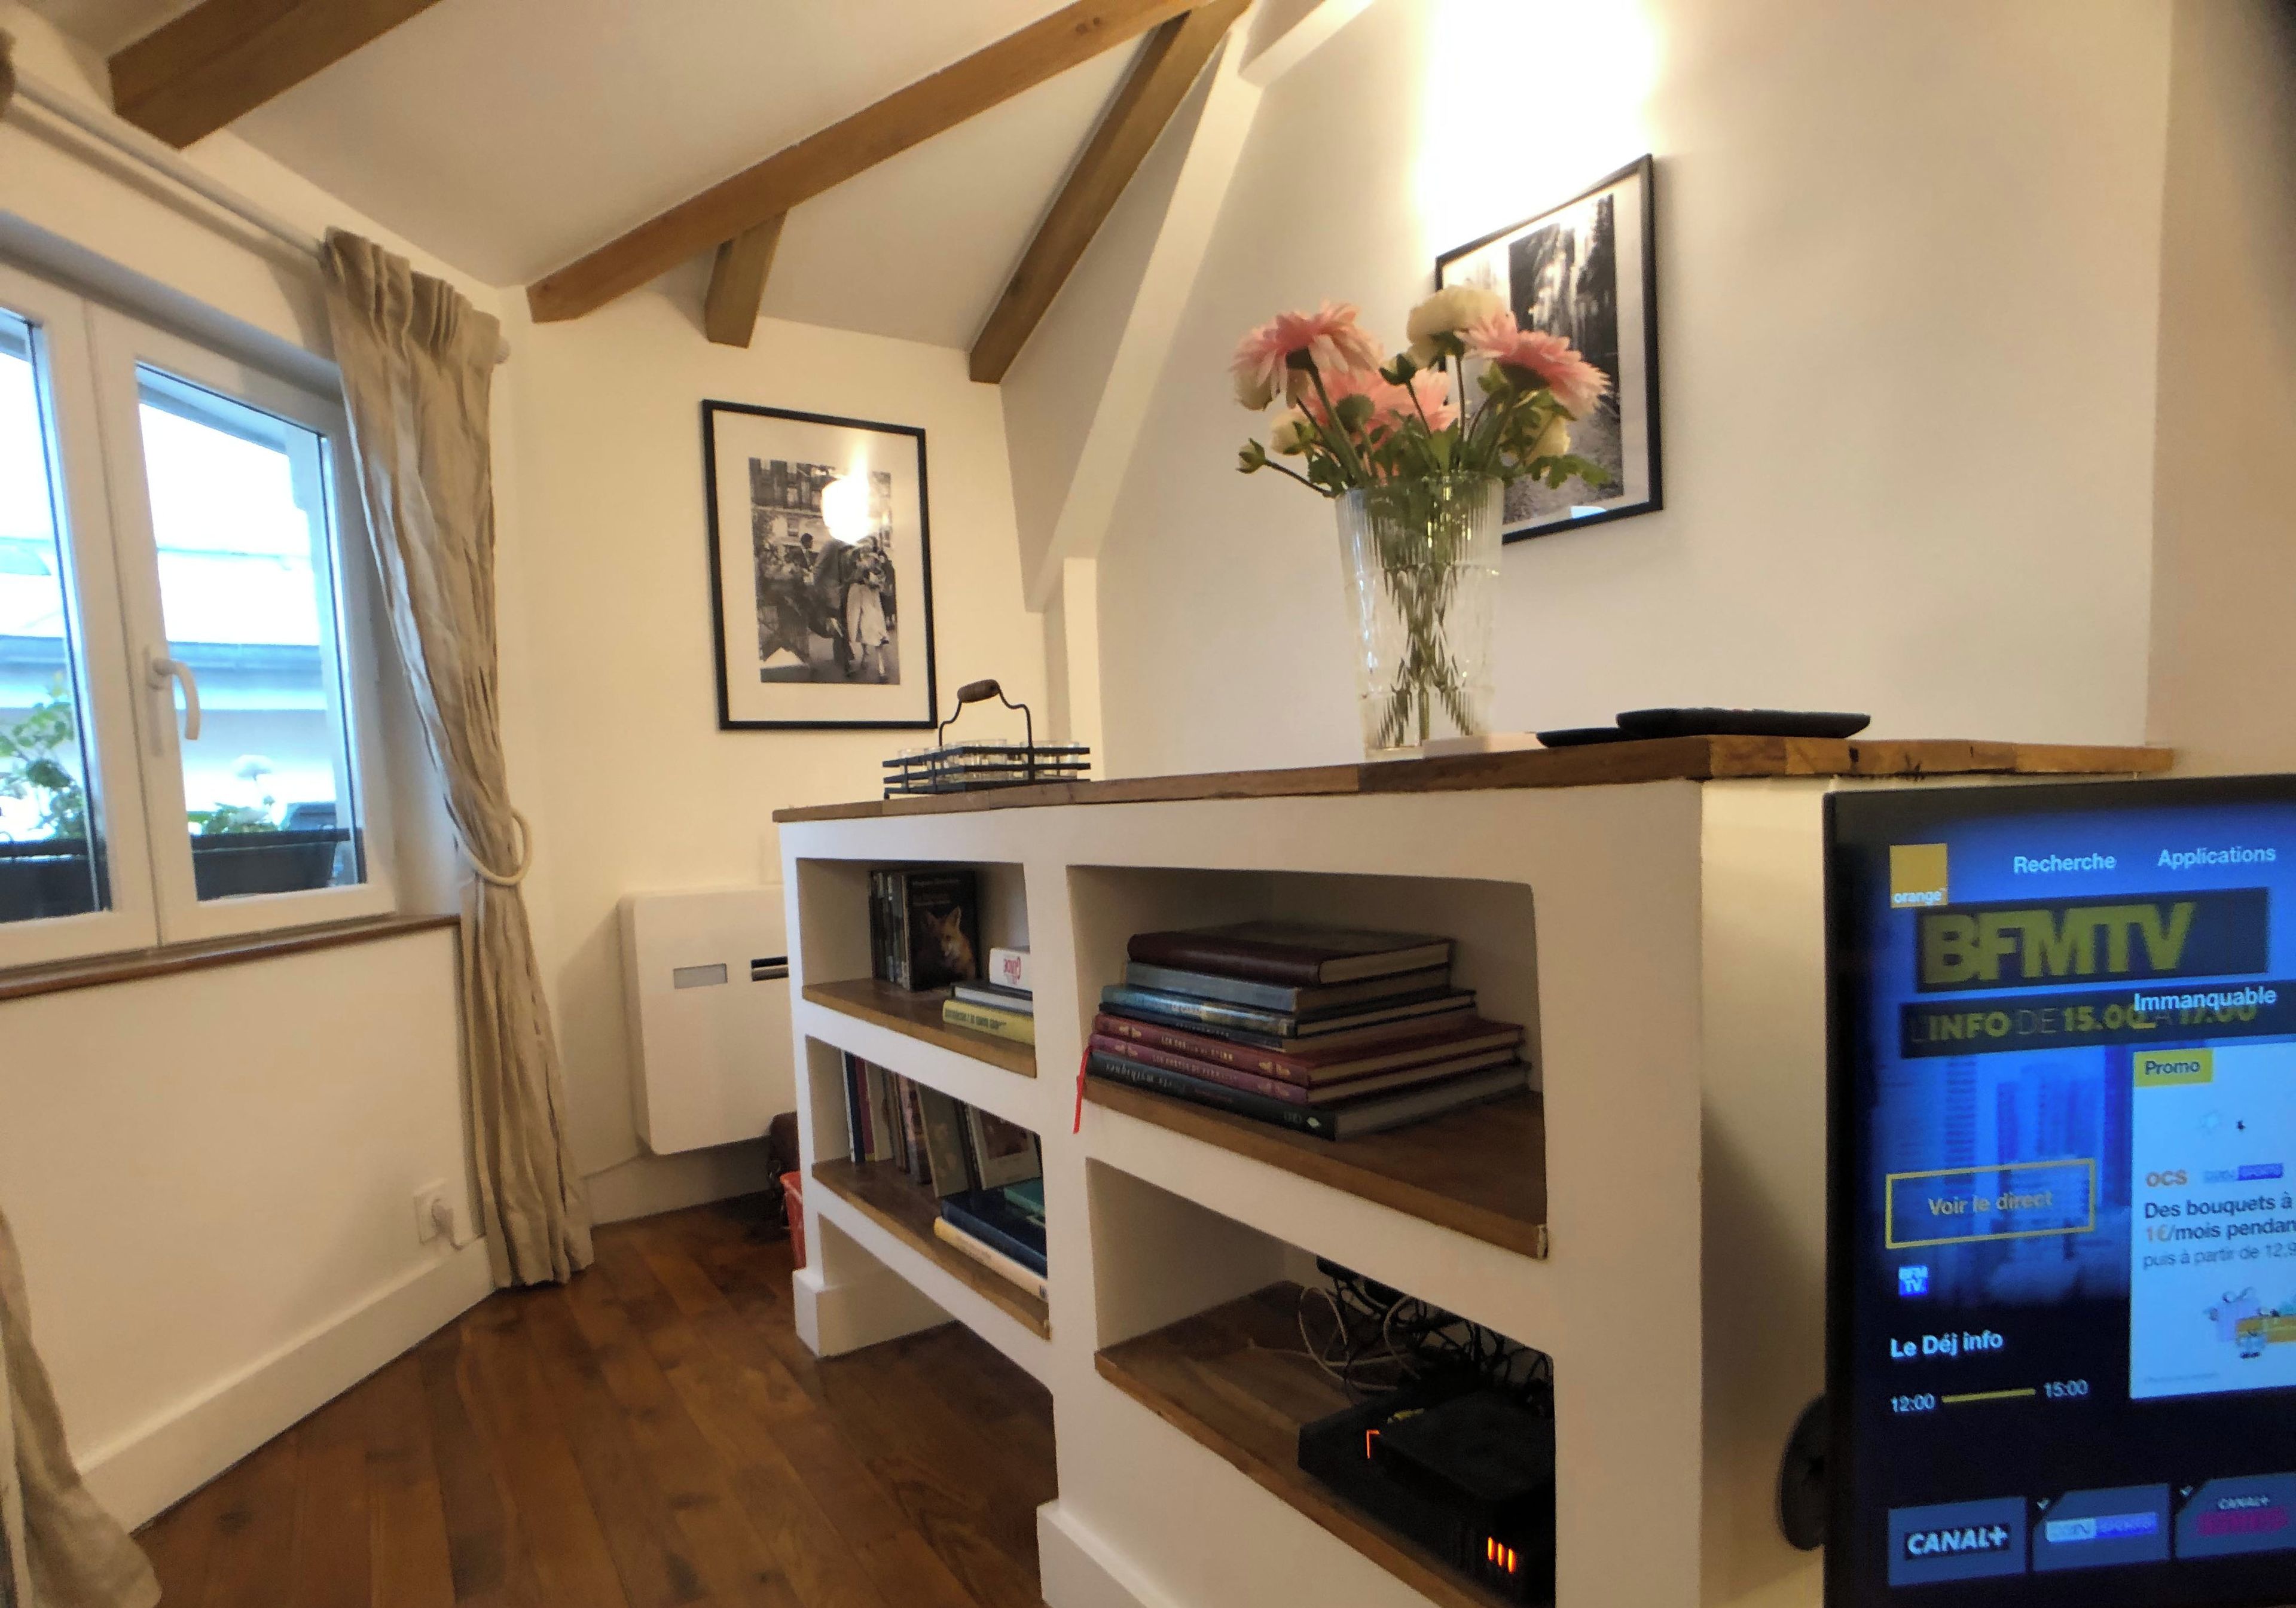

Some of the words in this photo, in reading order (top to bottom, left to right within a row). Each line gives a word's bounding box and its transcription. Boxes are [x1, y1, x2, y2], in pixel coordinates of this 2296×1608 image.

[2013, 853, 2117, 874] Recherche
[2158, 846, 2277, 870] Applications
[1893, 890, 1943, 906] orange
[1922, 902, 2196, 985] BFMTV
[2133, 985, 2278, 1012] Immanquable
[2145, 1060, 2202, 1076] Promo
[1928, 1197, 1968, 1216] Voir
[1973, 1195, 1990, 1212] le
[1995, 1191, 2053, 1210] direct
[2144, 1202, 2181, 1219] Des
[2185, 1195, 2276, 1217] bouquets
[2280, 1191, 2293, 1210] à
[2142, 1253, 2176, 1271] puis
[2193, 1246, 2235, 1266] partir
[2239, 1246, 2260, 1260] de
[1891, 1338, 1917, 1358] Le
[1922, 1332, 1958, 1357] Déj
[1962, 1329, 2004, 1351] info
[2043, 1379, 2090, 1398] 15:00
[1891, 1393, 1936, 1413] 12:00
[1907, 1524, 2008, 1556] CANAL+
